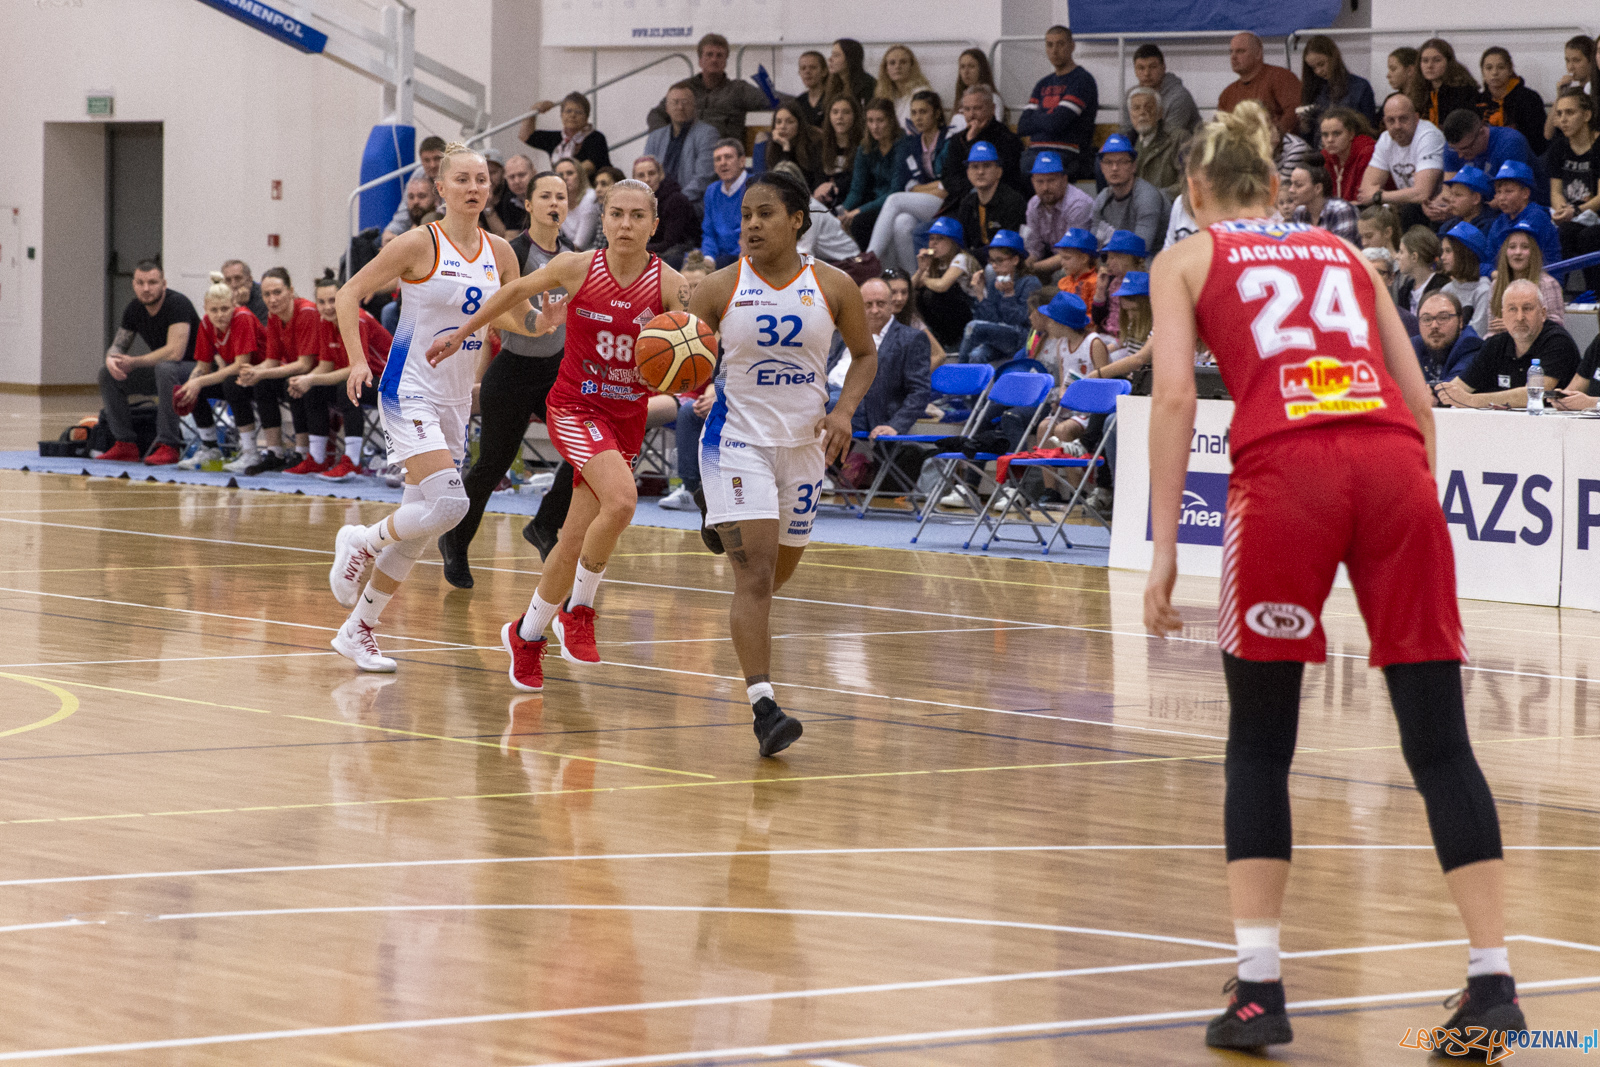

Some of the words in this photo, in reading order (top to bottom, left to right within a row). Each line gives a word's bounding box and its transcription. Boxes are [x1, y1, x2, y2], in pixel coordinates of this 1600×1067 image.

[1227, 244, 1351, 264] JACKOWSKA
[461, 286, 483, 316] 8
[1235, 264, 1371, 360] 24
[460, 338, 483, 351] nea
[755, 314, 803, 348] 32
[595, 330, 635, 363] 88
[756, 369, 816, 386] Enea
[1179, 503, 1222, 527] nea
[1441, 469, 1553, 546] AZS
